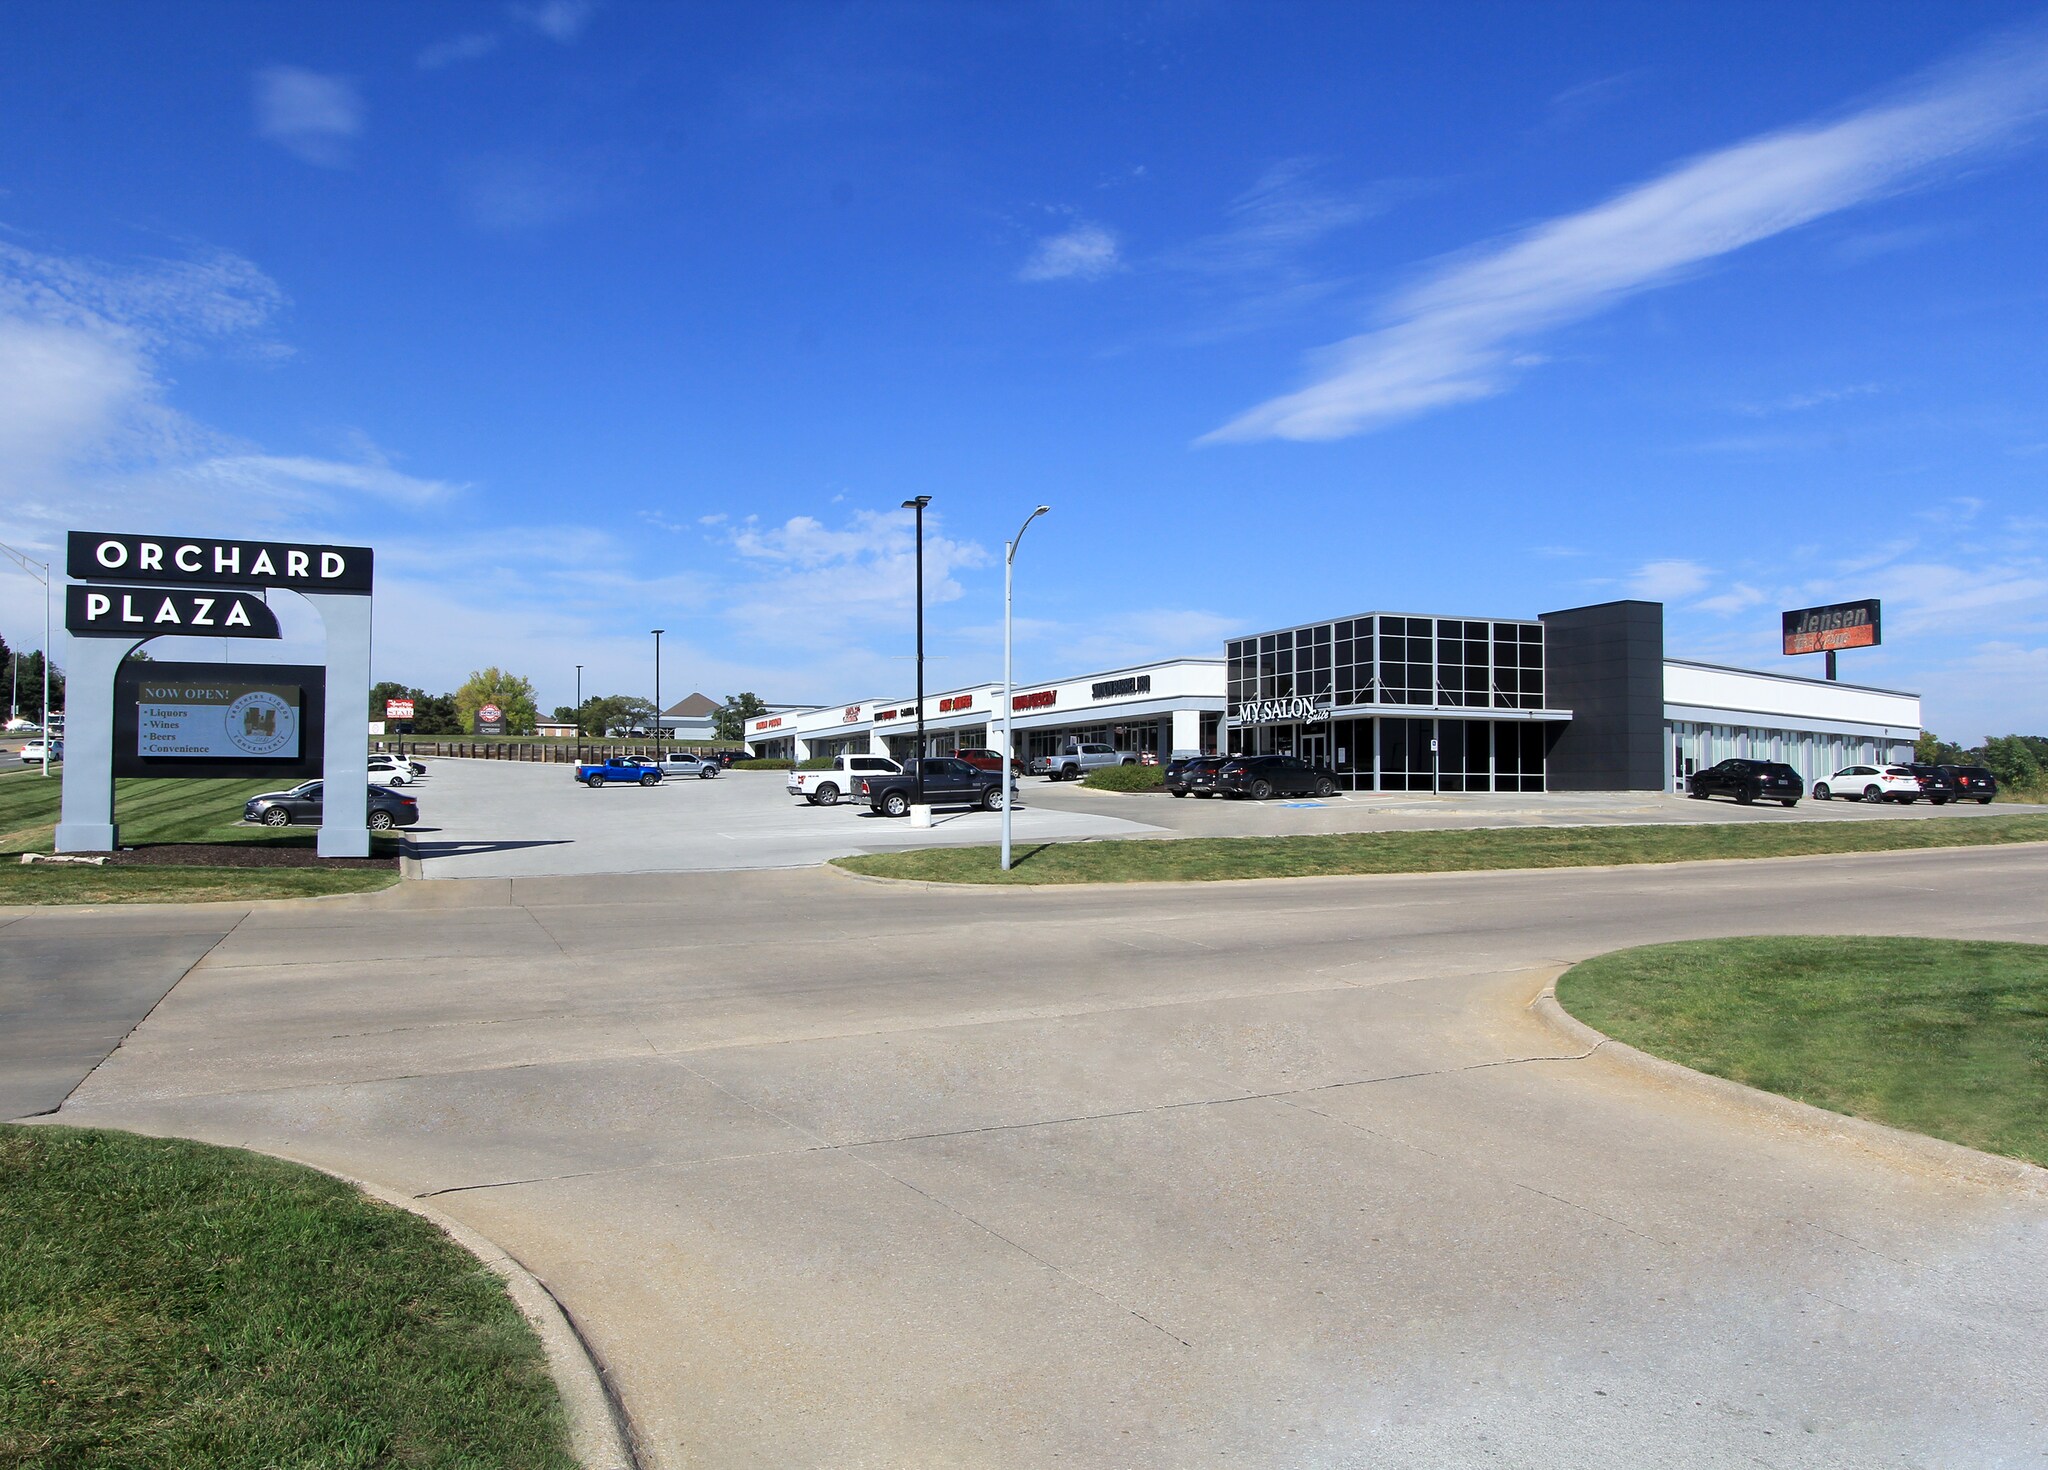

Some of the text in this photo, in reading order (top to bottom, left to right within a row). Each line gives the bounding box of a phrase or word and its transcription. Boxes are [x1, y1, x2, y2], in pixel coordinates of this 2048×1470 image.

[96, 540, 346, 578] ORCHARD
[86, 593, 251, 627] PLAZA
[1796, 608, 1867, 633] Jensen
[145, 688, 229, 699] NOW OPEN!
[150, 709, 188, 718] Liquors
[1239, 697, 1315, 722] MY SALON
[150, 721, 180, 729] Wines
[150, 733, 177, 741] Beers
[233, 735, 286, 752] CONVENIENCE
[149, 744, 210, 753] Convenience
